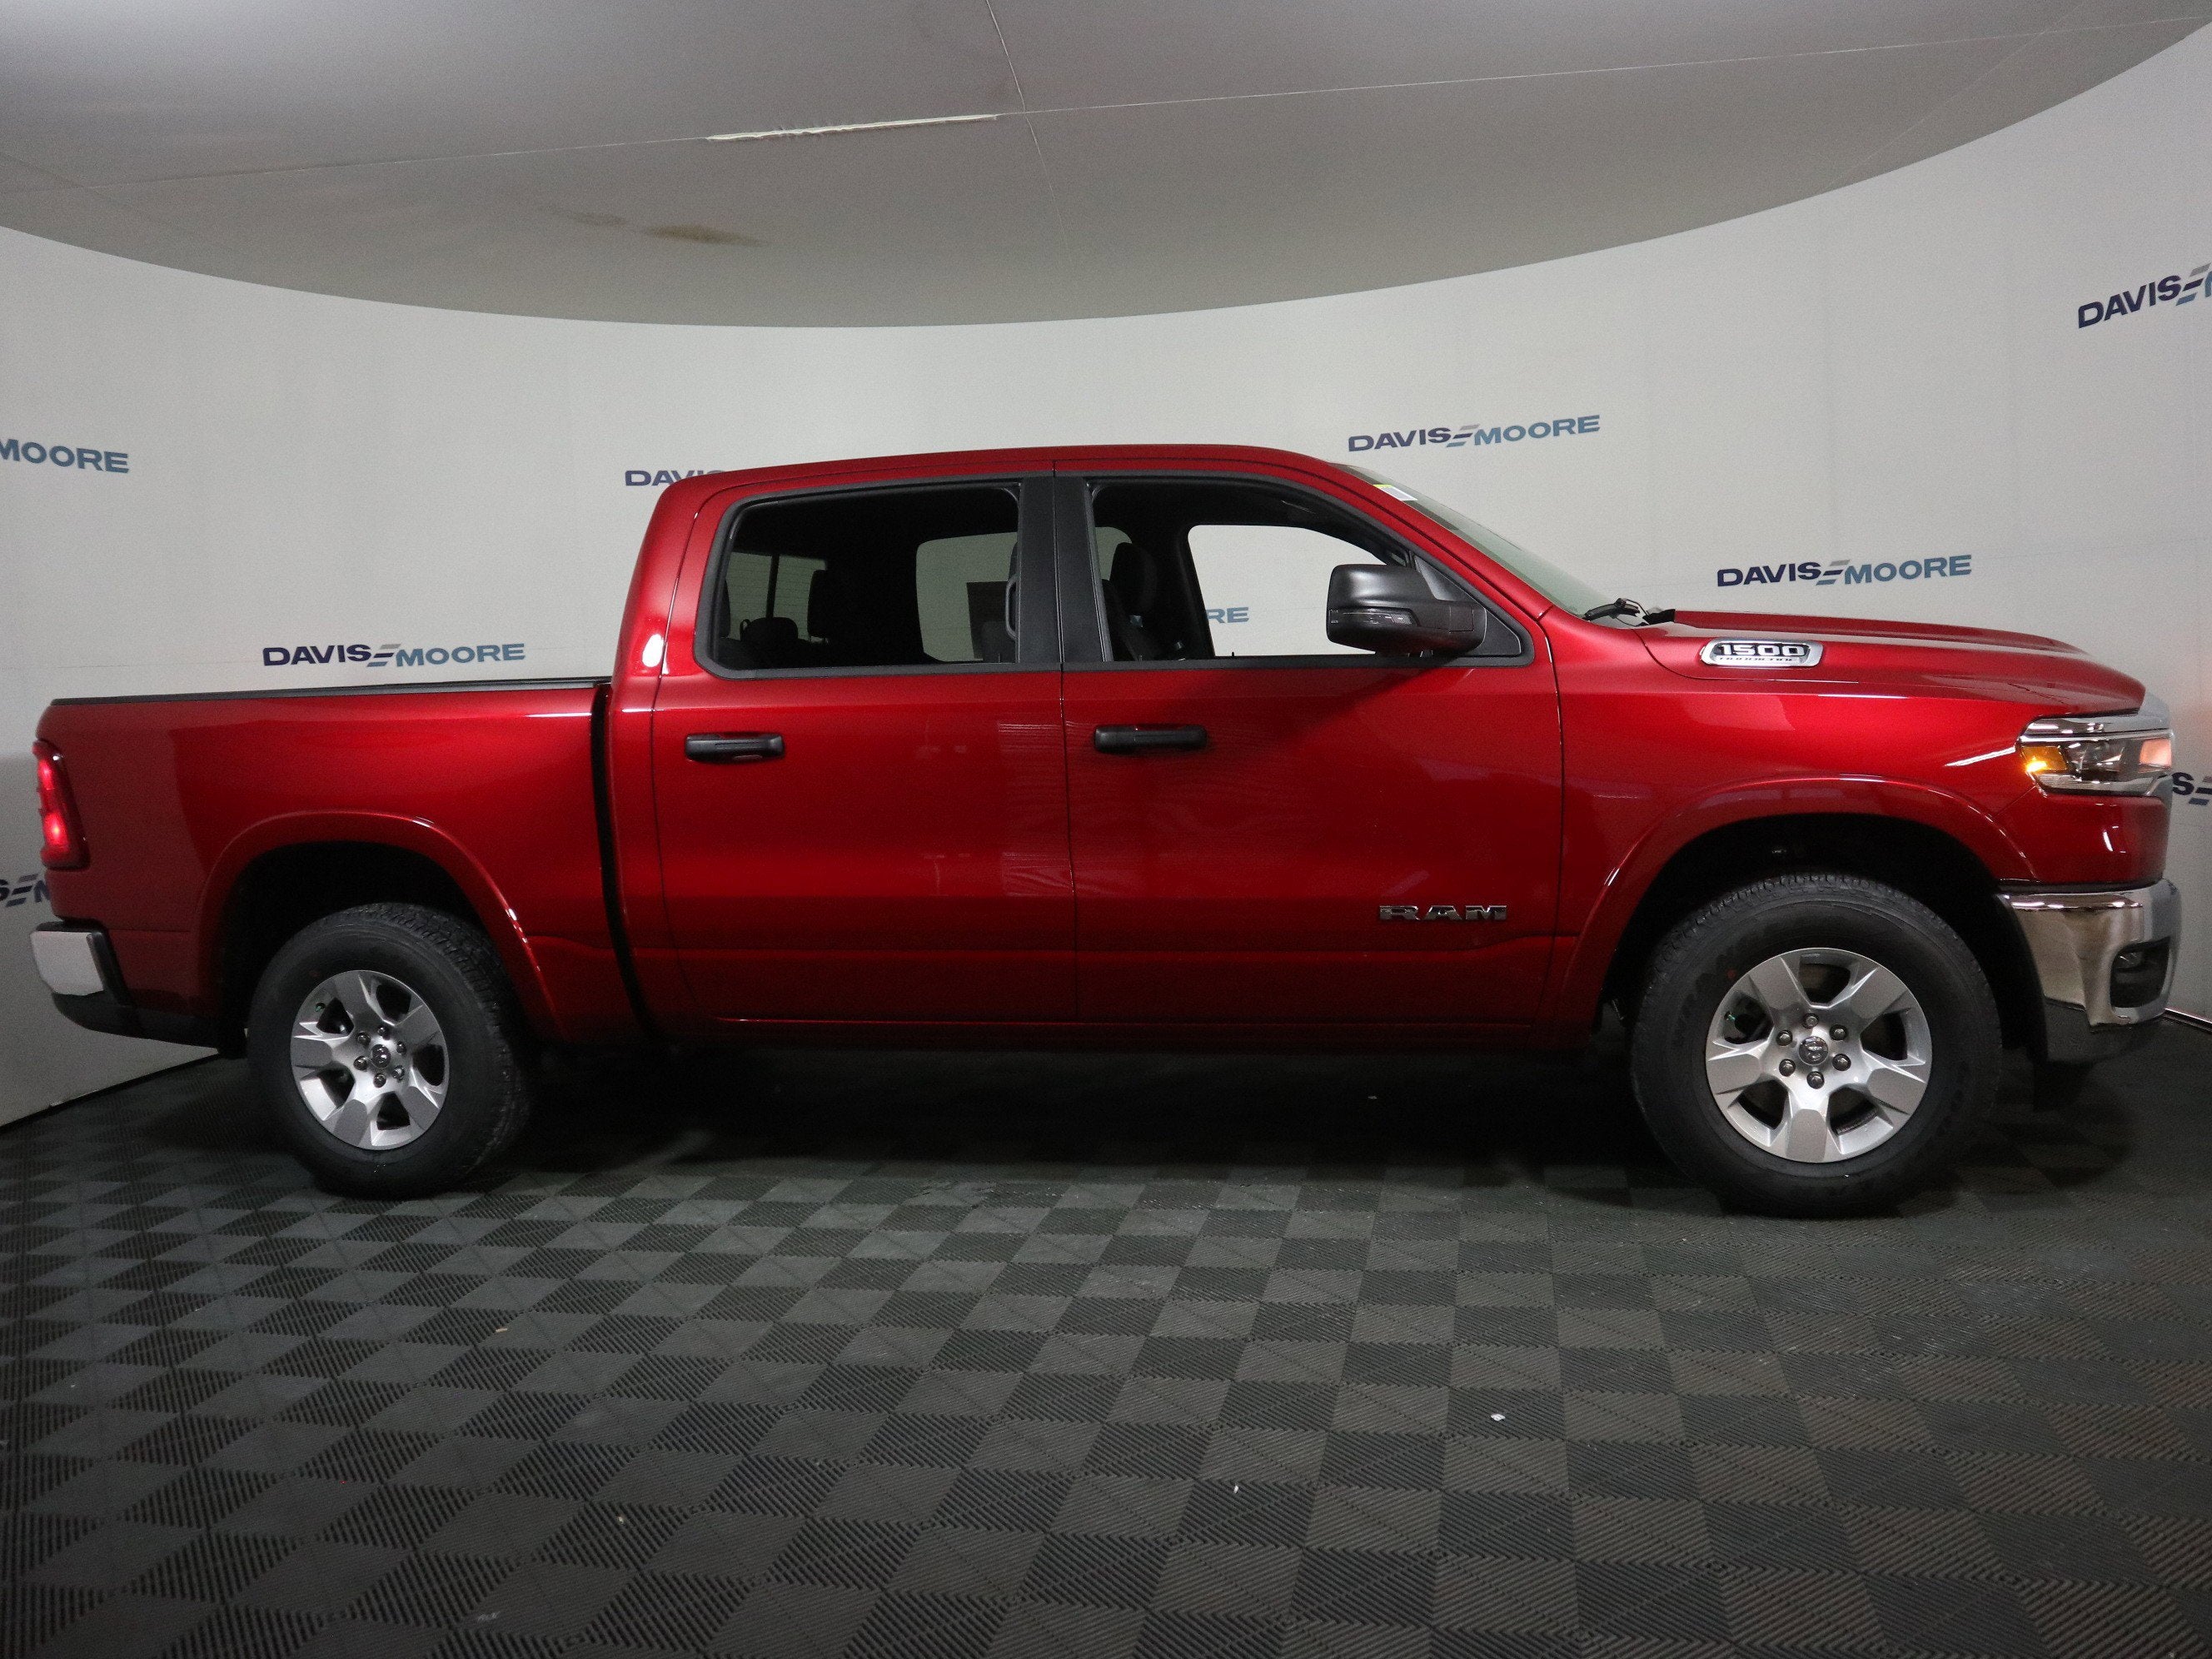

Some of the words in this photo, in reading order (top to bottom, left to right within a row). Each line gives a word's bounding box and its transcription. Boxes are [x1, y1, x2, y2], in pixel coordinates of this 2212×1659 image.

[2078, 275, 2182, 329] DAVIS
[1348, 427, 1452, 452] DAVIS
[1474, 415, 1601, 446] MOORE
[1717, 561, 1821, 587] DAVIS
[1844, 554, 1972, 585] MOORE
[262, 644, 372, 666] DAVIS
[396, 643, 526, 667] MOORE
[1721, 643, 1806, 656] 1500
[1379, 904, 1507, 920] RAM
